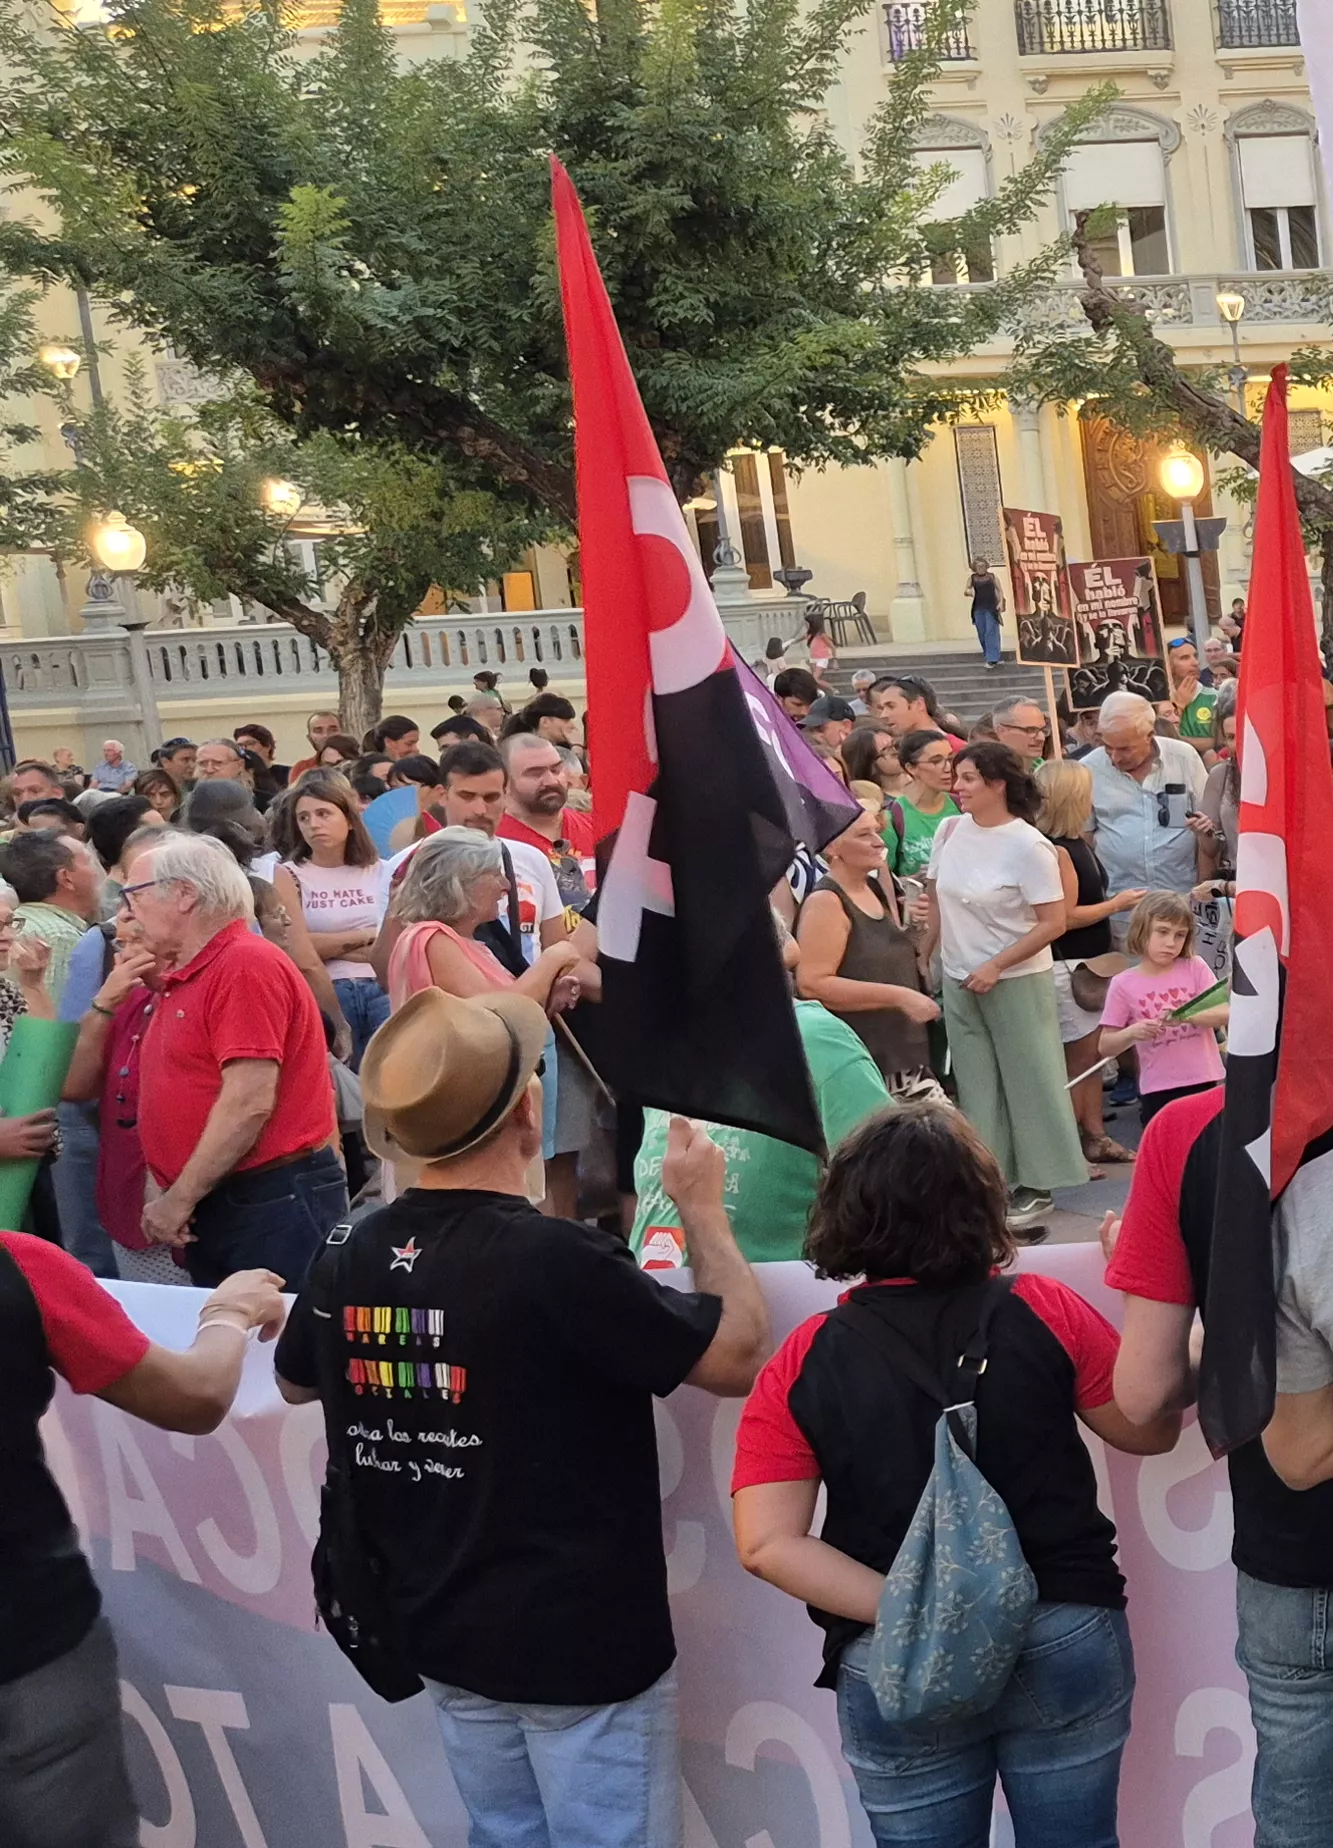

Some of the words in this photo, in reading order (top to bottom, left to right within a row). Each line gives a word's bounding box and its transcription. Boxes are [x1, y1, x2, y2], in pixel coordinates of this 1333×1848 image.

[1084, 562, 1122, 589] ÉL
[1085, 585, 1126, 601] habló
[311, 891, 328, 900] NO
[333, 889, 365, 899] HATE
[340, 895, 375, 908] CAKE
